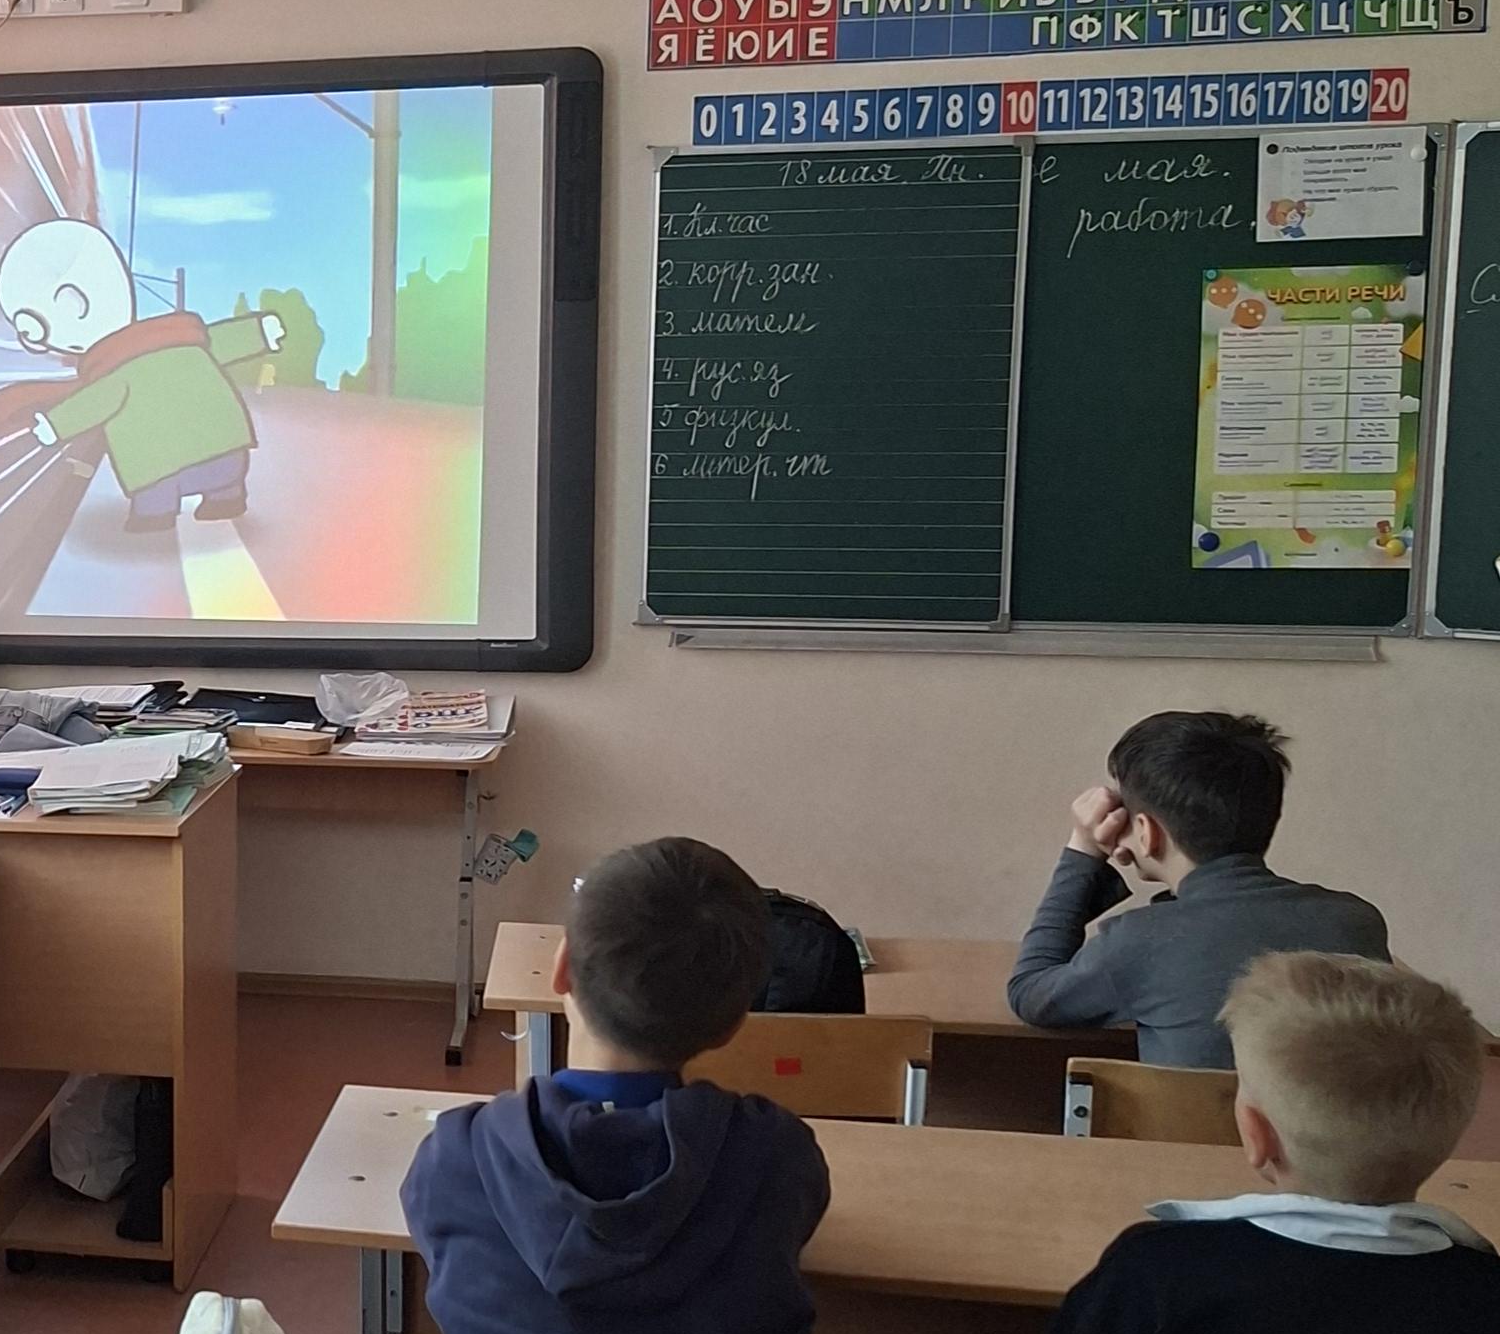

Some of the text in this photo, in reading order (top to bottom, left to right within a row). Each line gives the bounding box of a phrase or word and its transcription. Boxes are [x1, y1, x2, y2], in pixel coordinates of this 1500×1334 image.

[700, 77, 1406, 138] 0 1 2 3 4 5 6 7 8 9 10 11 12 13 14 15 16 17 18 19 20
[779, 160, 811, 186] 18
[1267, 284, 1406, 304] ЧАСТИ РЕЧИ
[654, 453, 669, 475] 6
